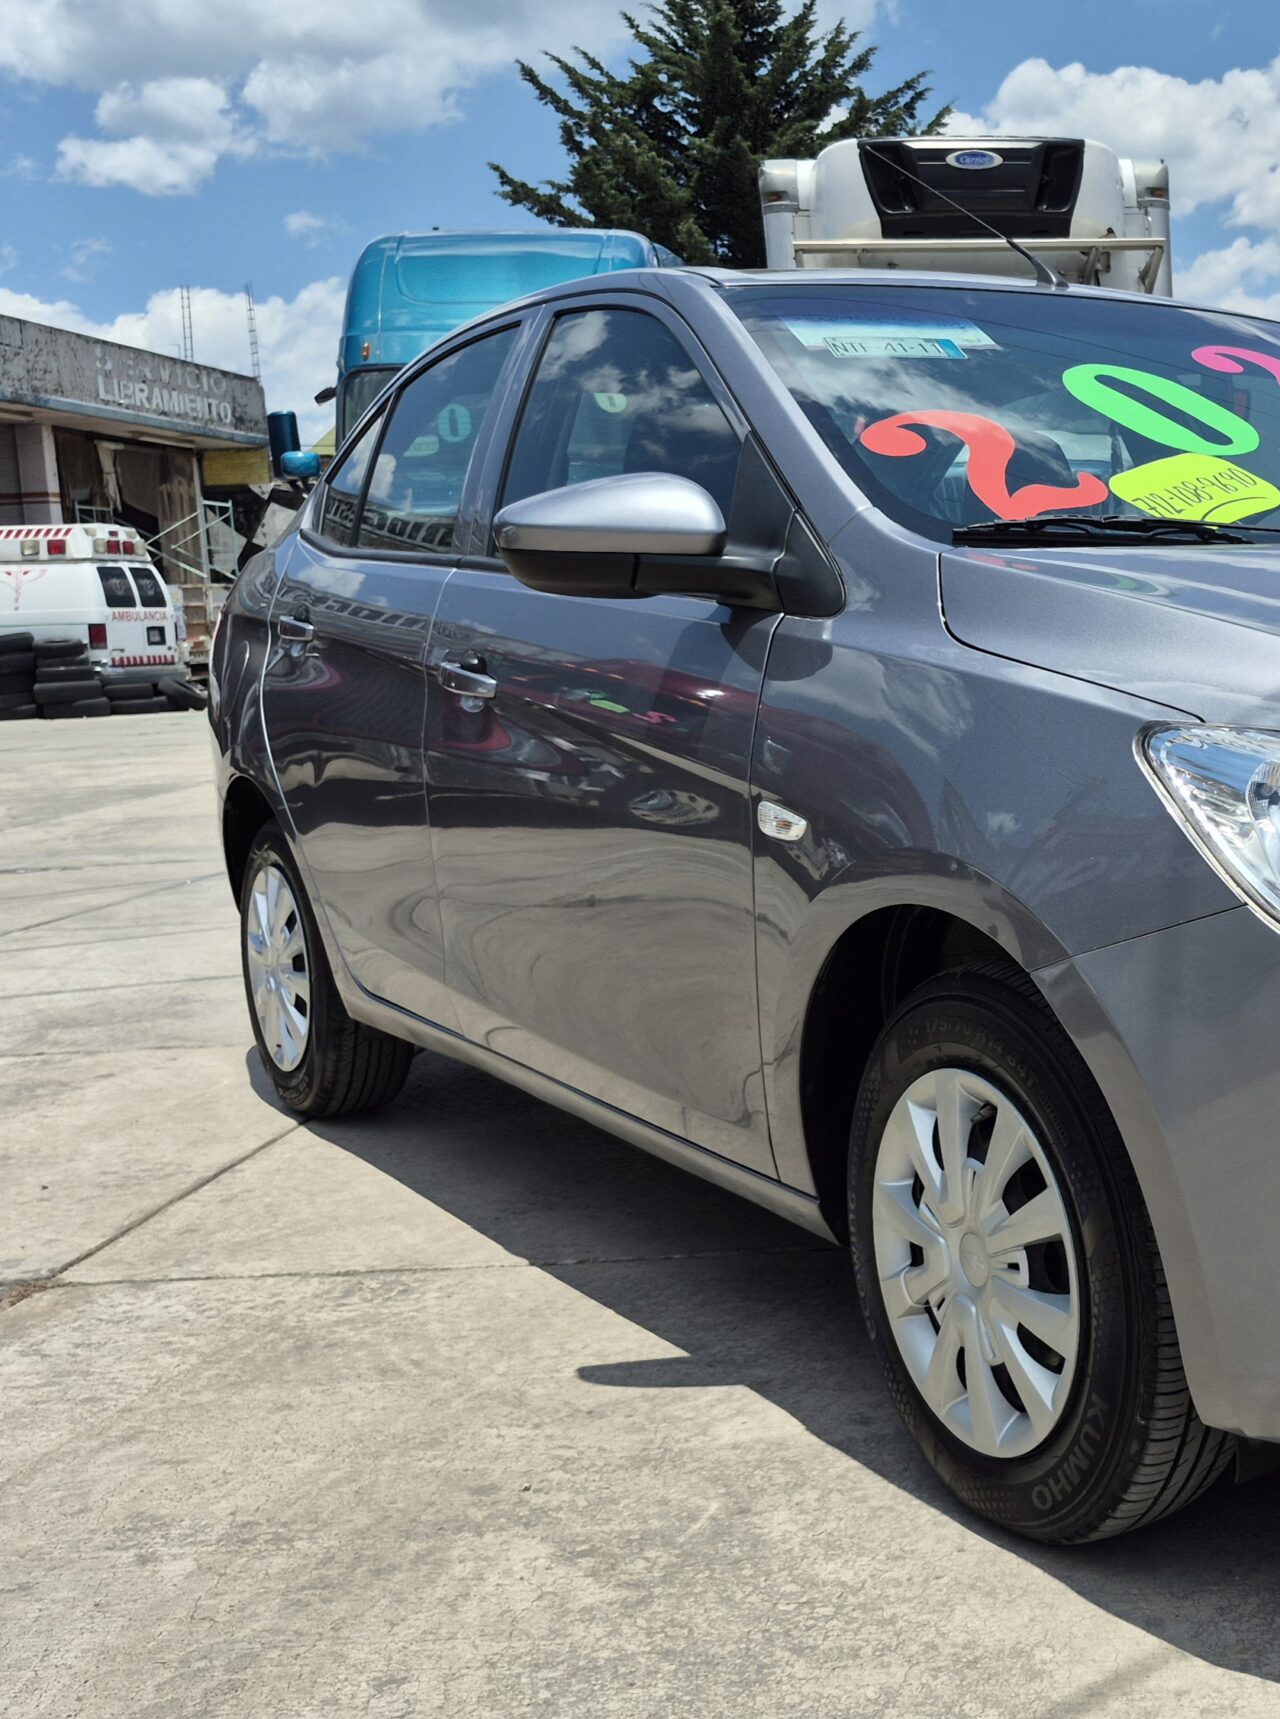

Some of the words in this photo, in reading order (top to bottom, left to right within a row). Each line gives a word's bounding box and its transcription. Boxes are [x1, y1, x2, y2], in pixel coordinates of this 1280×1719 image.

[97, 375, 232, 424] LIBRAMIENTO
[860, 409, 1109, 521] 2
[1062, 363, 1260, 456] 0
[112, 610, 168, 622] AMBULANCIA
[1031, 1391, 1108, 1511] KUMHO
